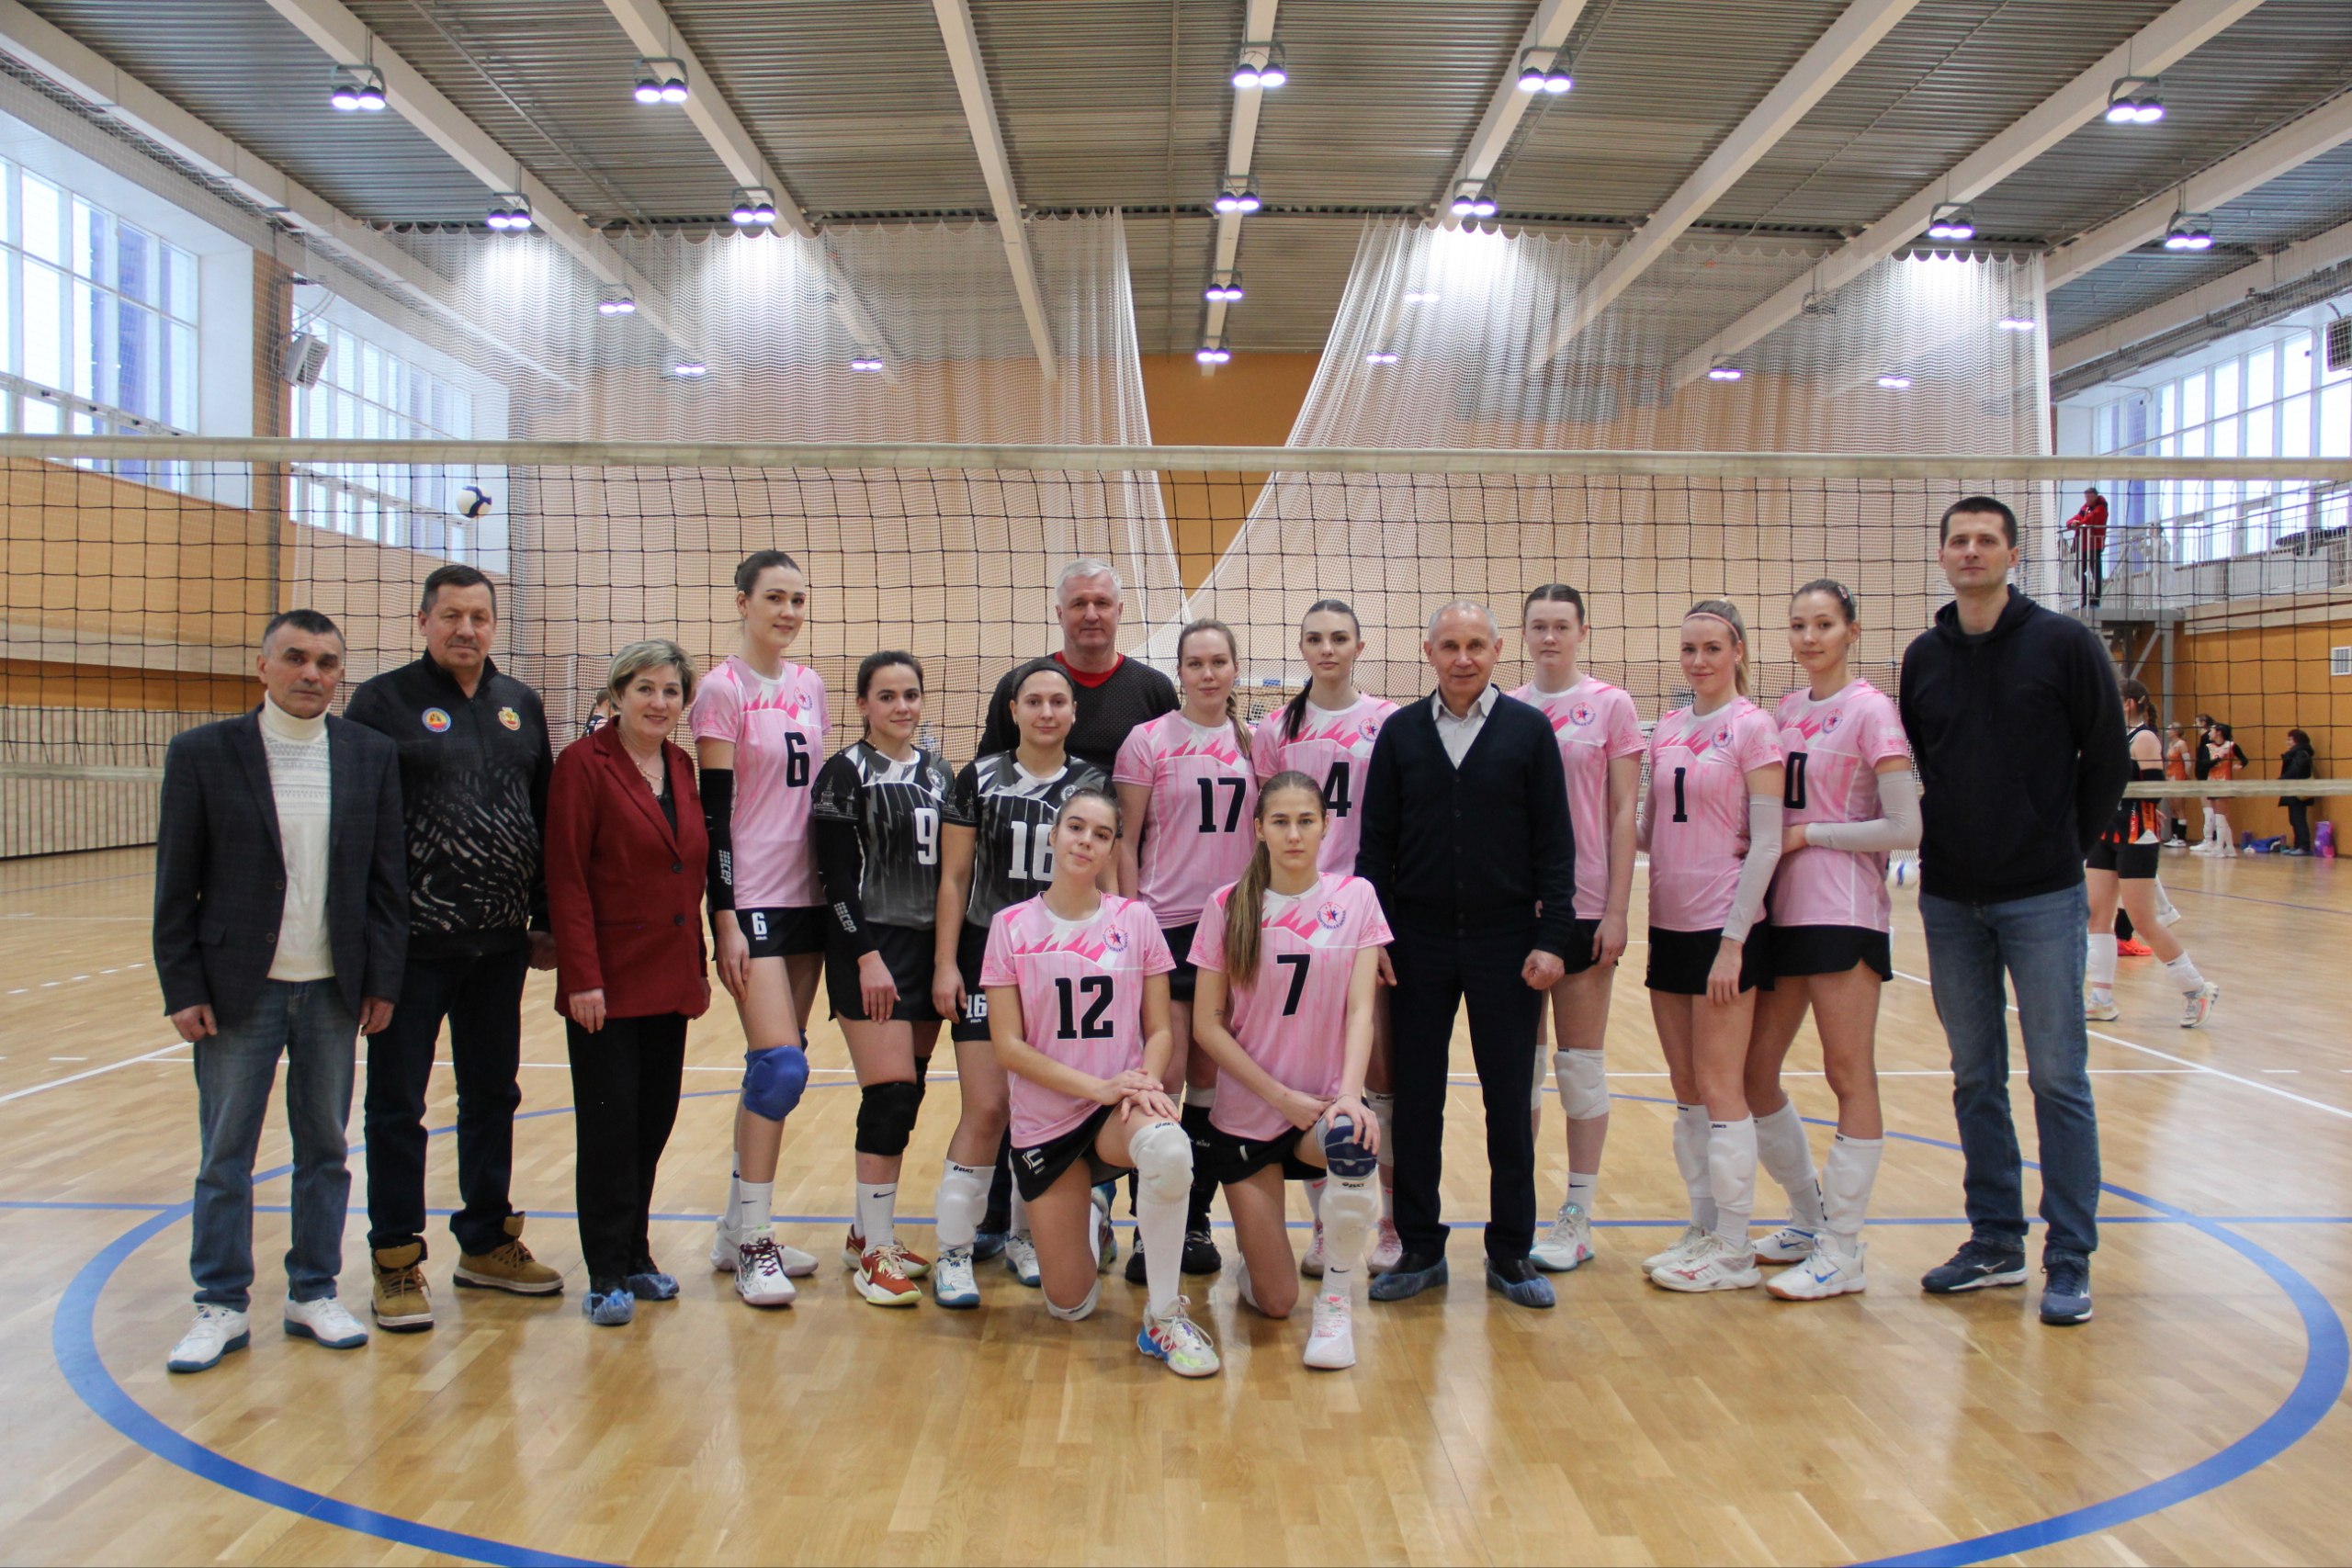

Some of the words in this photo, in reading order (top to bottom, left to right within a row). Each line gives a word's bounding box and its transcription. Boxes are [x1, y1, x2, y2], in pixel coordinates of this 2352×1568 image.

[784, 731, 810, 787] 6
[1197, 777, 1246, 833] 17
[1322, 761, 1352, 818] 4
[1672, 767, 1688, 822] 1
[914, 807, 939, 865] 9
[1008, 820, 1055, 882] 16
[752, 912, 767, 935] 6
[839, 913, 857, 932] cep
[966, 994, 988, 1019] 16
[1055, 976, 1114, 1039] 12
[1277, 953, 1311, 1017] 7
